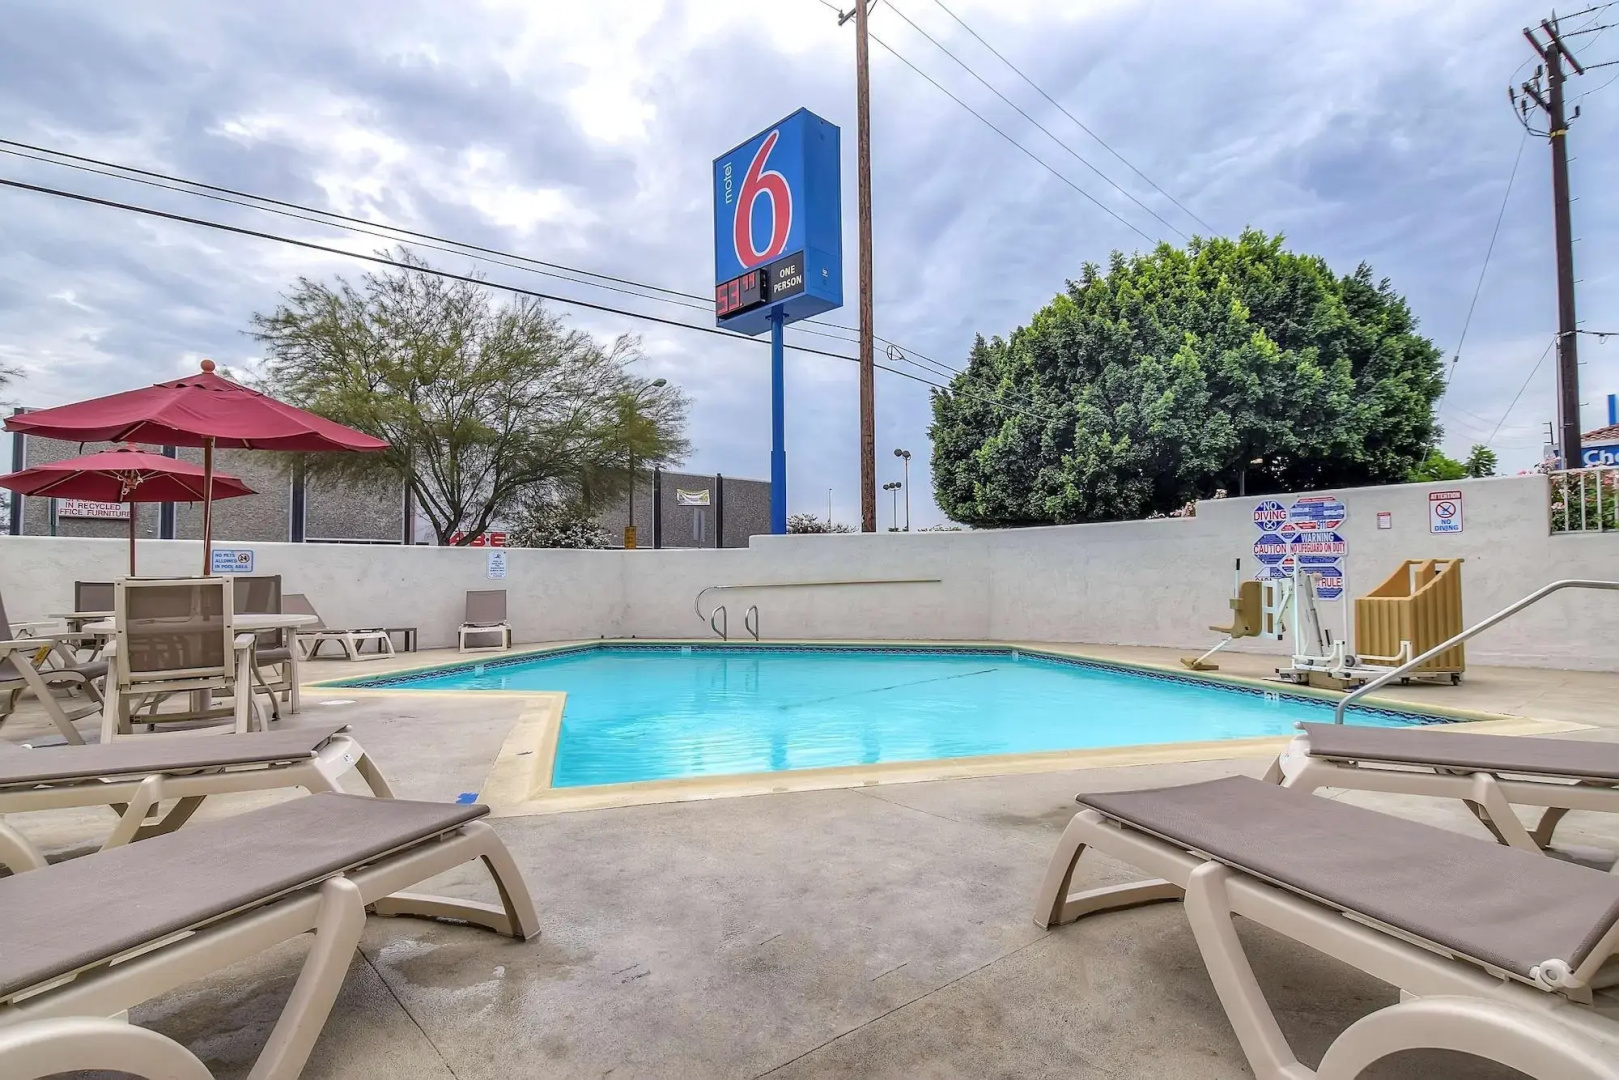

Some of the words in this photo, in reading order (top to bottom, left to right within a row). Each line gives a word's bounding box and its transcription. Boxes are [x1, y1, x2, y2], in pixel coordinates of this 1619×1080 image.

[724, 161, 732, 204] motel
[733, 129, 793, 270] 6
[780, 264, 796, 278] ONE
[773, 274, 802, 293] PERSON
[77, 502, 121, 510] RECYCLED
[1263, 502, 1277, 511] NO
[86, 509, 131, 518] FURNITURE
[1254, 511, 1287, 520] DIVING
[1316, 521, 1327, 529] 911
[1301, 532, 1334, 542] WARNING
[1254, 545, 1287, 553] CAUTION
[1290, 544, 1297, 552] NO
[1298, 543, 1323, 552] LIFEGUARD
[1324, 542, 1332, 552] ON
[1332, 542, 1345, 552] DUTY
[1321, 577, 1342, 587] RULE
